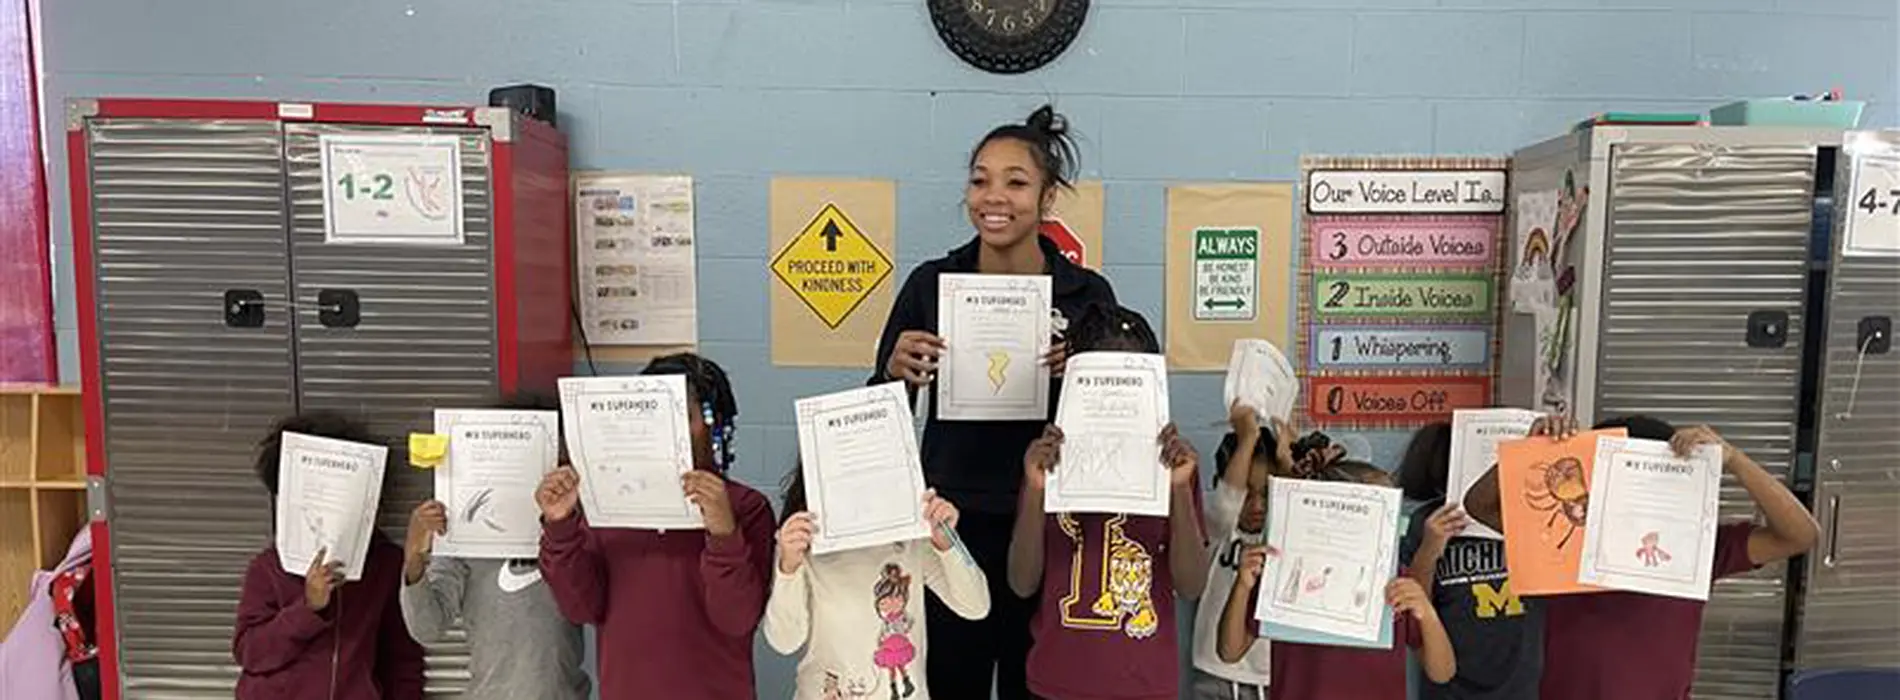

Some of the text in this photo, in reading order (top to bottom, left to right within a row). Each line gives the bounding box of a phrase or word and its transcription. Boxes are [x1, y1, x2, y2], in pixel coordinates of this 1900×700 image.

[986, 8, 996, 28] 7
[1003, 15, 1016, 32] 6
[1022, 9, 1034, 27] 5
[339, 173, 394, 200] 1-2
[1313, 180, 1352, 204] Our
[1358, 180, 1406, 204] Voice
[1412, 181, 1459, 203] Level
[1859, 187, 1900, 215] 4-7
[1198, 236, 1255, 255] ALWAYS
[1329, 232, 1485, 260] 3 Outside Voices
[788, 260, 875, 274] PROCEED WITH
[1204, 263, 1248, 272] BE HONEST
[803, 278, 863, 293] KINDNESS
[1222, 275, 1242, 283] KIND
[1210, 286, 1251, 295] FRIENDLY
[1325, 281, 1474, 308] 2 Inside Voices
[1330, 335, 1452, 364] 1 Whispering
[1327, 386, 1447, 415] 0 Voices Off
[1437, 540, 1505, 578] MICHI
[1471, 581, 1524, 618] M
